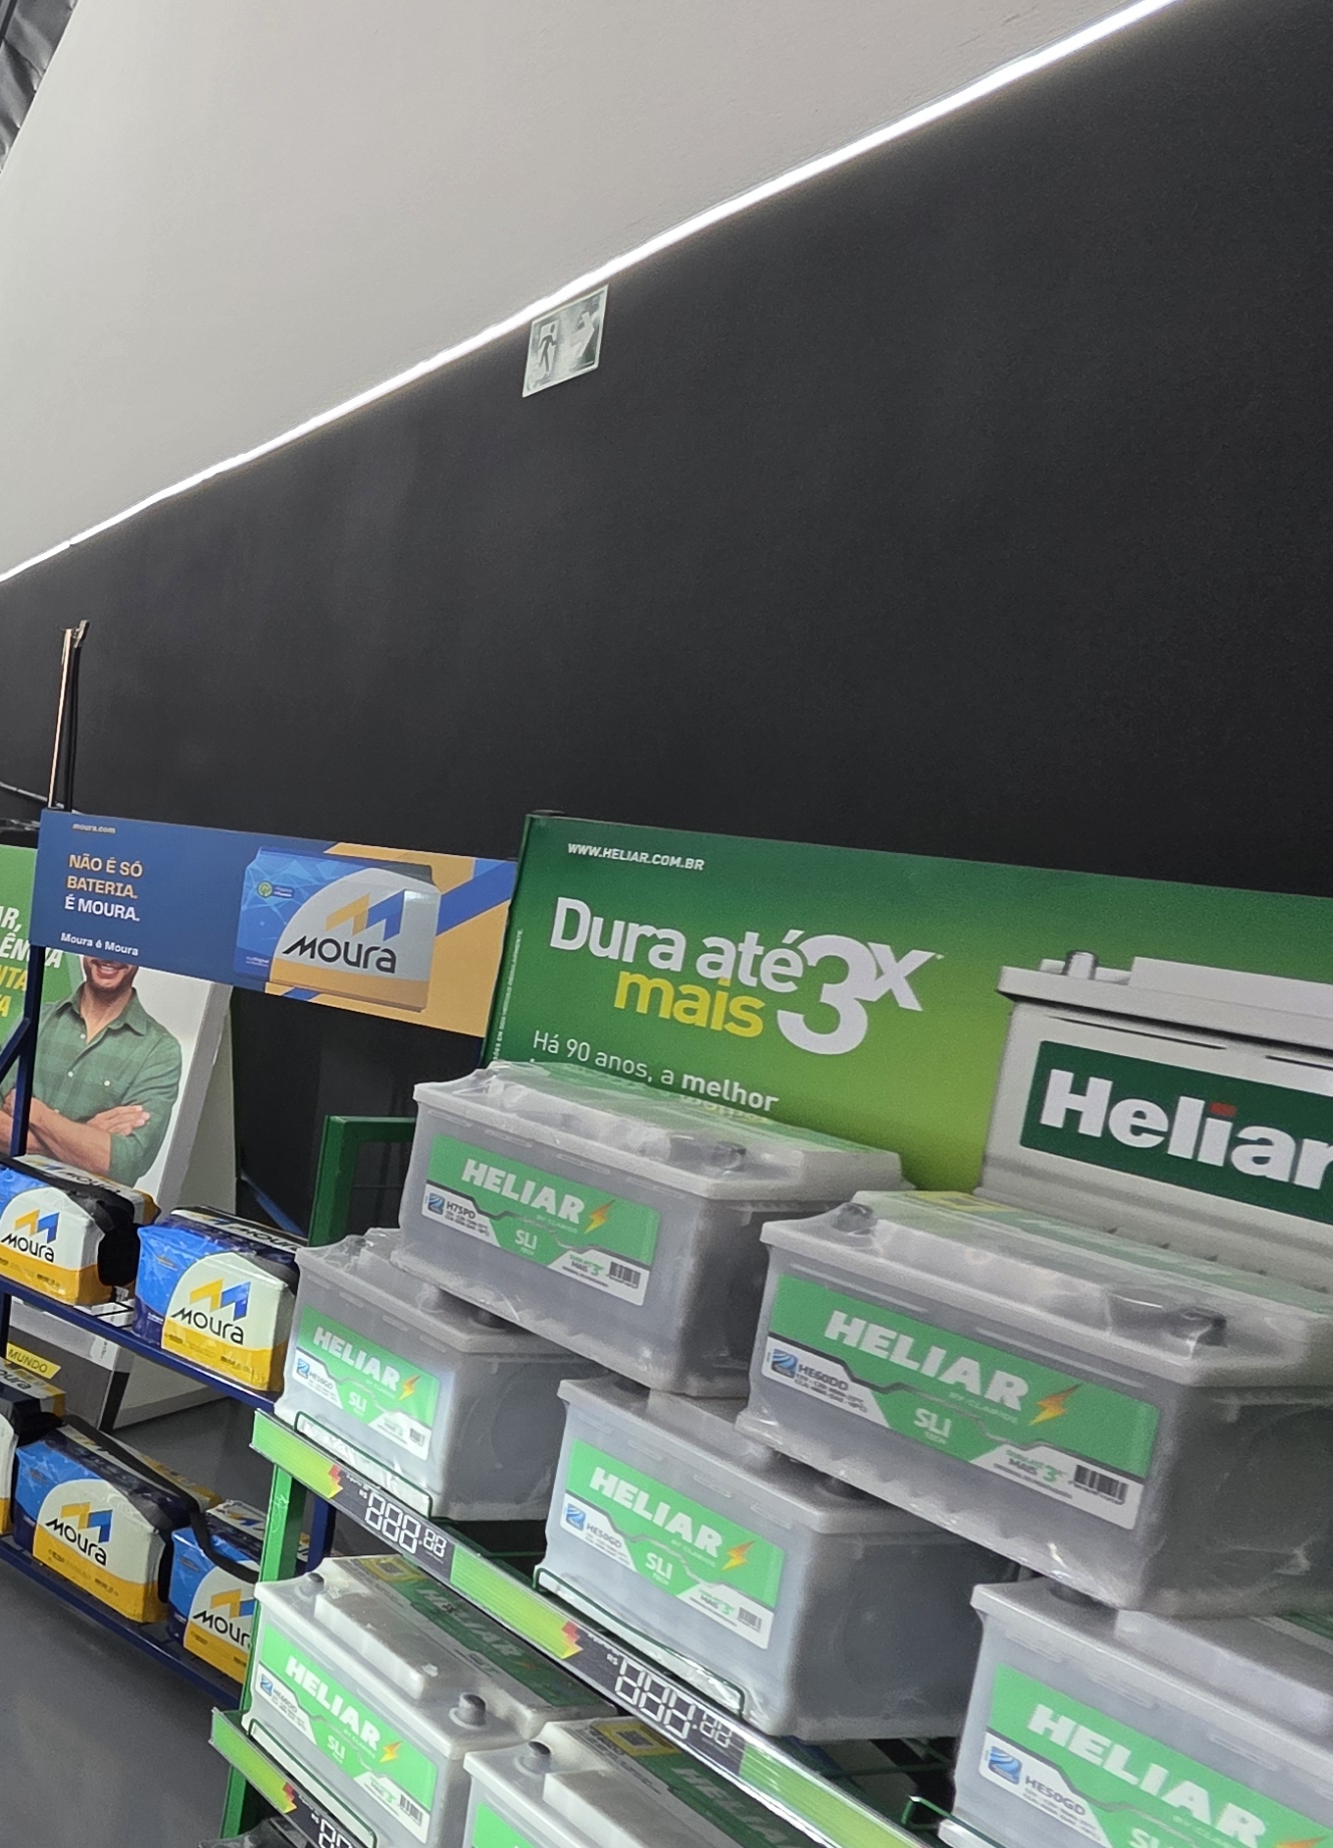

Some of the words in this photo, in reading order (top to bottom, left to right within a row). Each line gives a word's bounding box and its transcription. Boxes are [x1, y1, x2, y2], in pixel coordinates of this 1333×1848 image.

[73, 823, 116, 834] moura.com
[69, 853, 103, 873] NÃO
[106, 857, 117, 874] É
[119, 861, 144, 878] SÓ
[568, 842, 705, 871] WWW.HELIAR.COM.BR
[66, 875, 139, 899] BATERIA.
[64, 894, 76, 910] É
[77, 898, 141, 921] MOURA.
[60, 932, 94, 948] Moura
[104, 940, 140, 957] Moura
[550, 896, 686, 972] Dura
[696, 929, 804, 993] até
[614, 971, 766, 1038] mais
[533, 1030, 560, 1055] Há
[566, 1038, 591, 1063] 90
[595, 1051, 653, 1083] anos,
[660, 1069, 675, 1086] a
[681, 1074, 780, 1113] melhor
[1040, 1068, 1333, 1190] Heliar
[461, 1158, 586, 1224] HELIAR
[514, 1228, 538, 1250] SLI
[8, 1348, 49, 1374] MUNDO
[313, 1326, 401, 1391] HELIAR
[823, 1310, 1029, 1412] HELIAR
[348, 1391, 367, 1413] SLI
[913, 1407, 952, 1439] SLI
[589, 1467, 724, 1558] HELIAR
[645, 1552, 673, 1580] SLI
[285, 1655, 381, 1751] HELIAR
[327, 1735, 346, 1760] SLI
[1027, 1703, 1267, 1848] HELIAR
